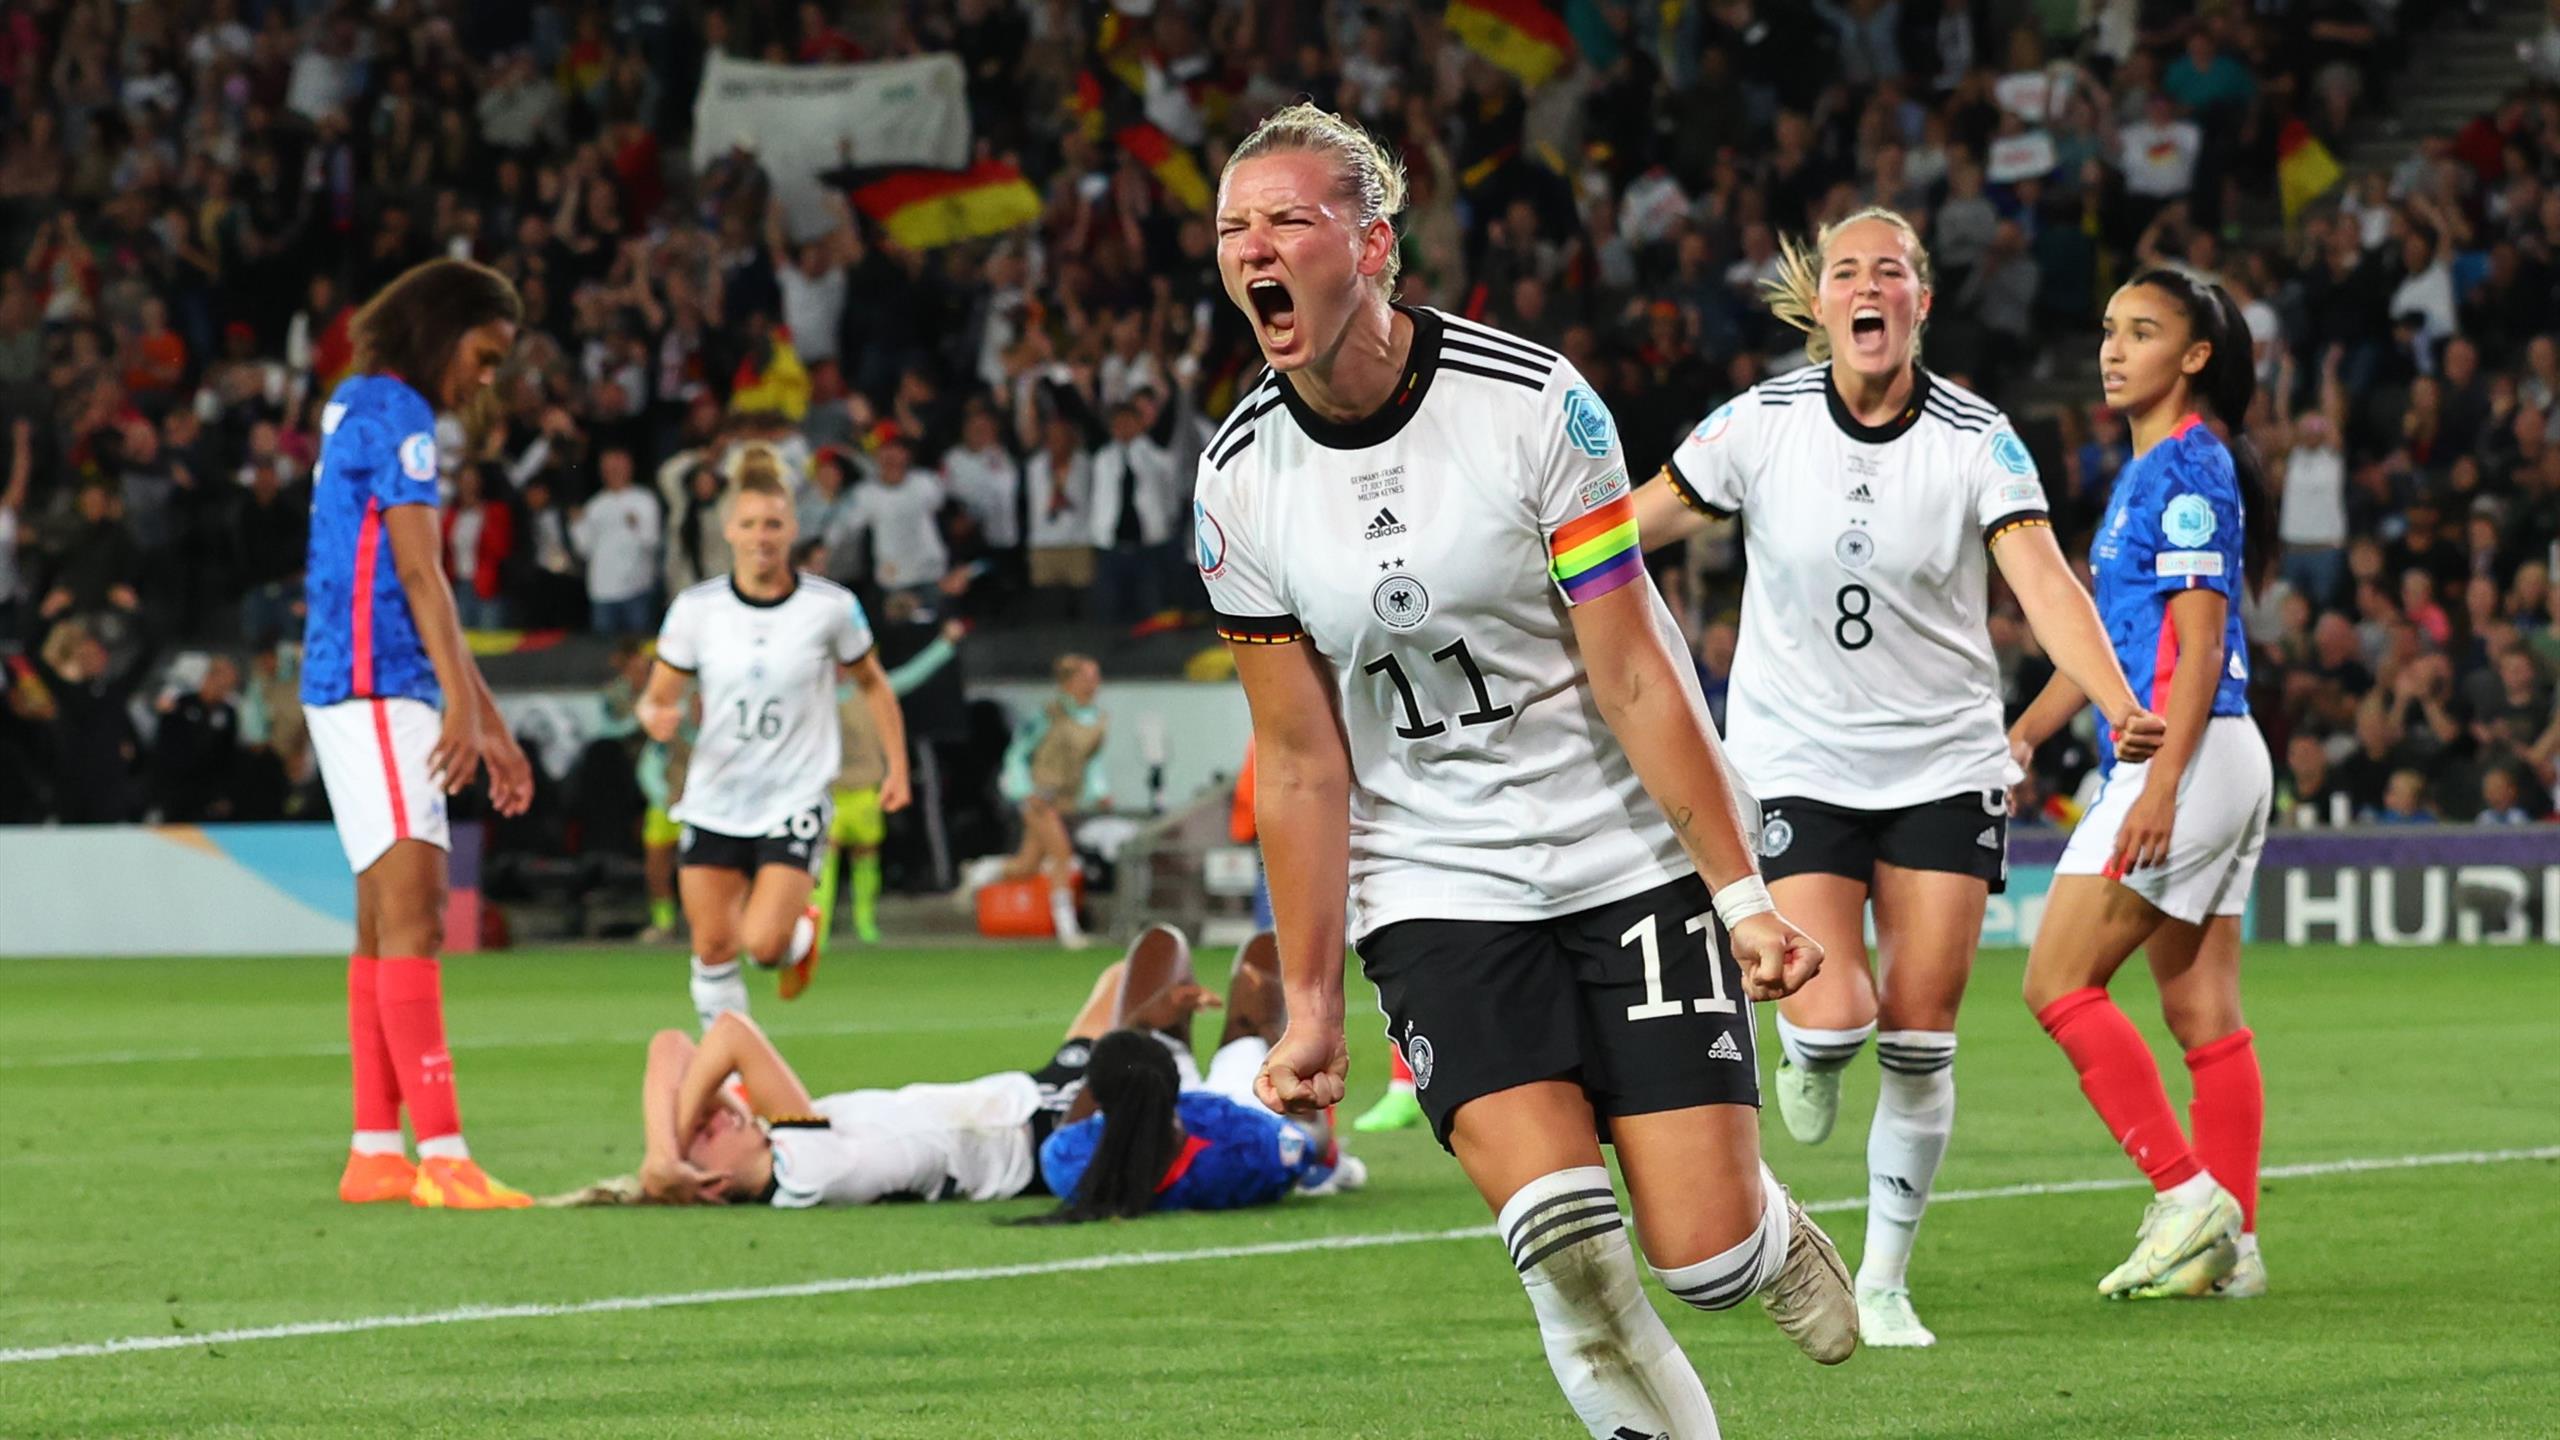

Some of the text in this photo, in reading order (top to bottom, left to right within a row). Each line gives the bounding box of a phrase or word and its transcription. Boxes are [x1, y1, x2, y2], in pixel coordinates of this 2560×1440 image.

[1364, 523, 1407, 540] adidas
[1835, 583, 1873, 651] 8
[1363, 637, 1515, 740] 11
[734, 698, 782, 740] 16
[1621, 910, 1737, 1022] 11
[1708, 1049, 1742, 1062] adidas
